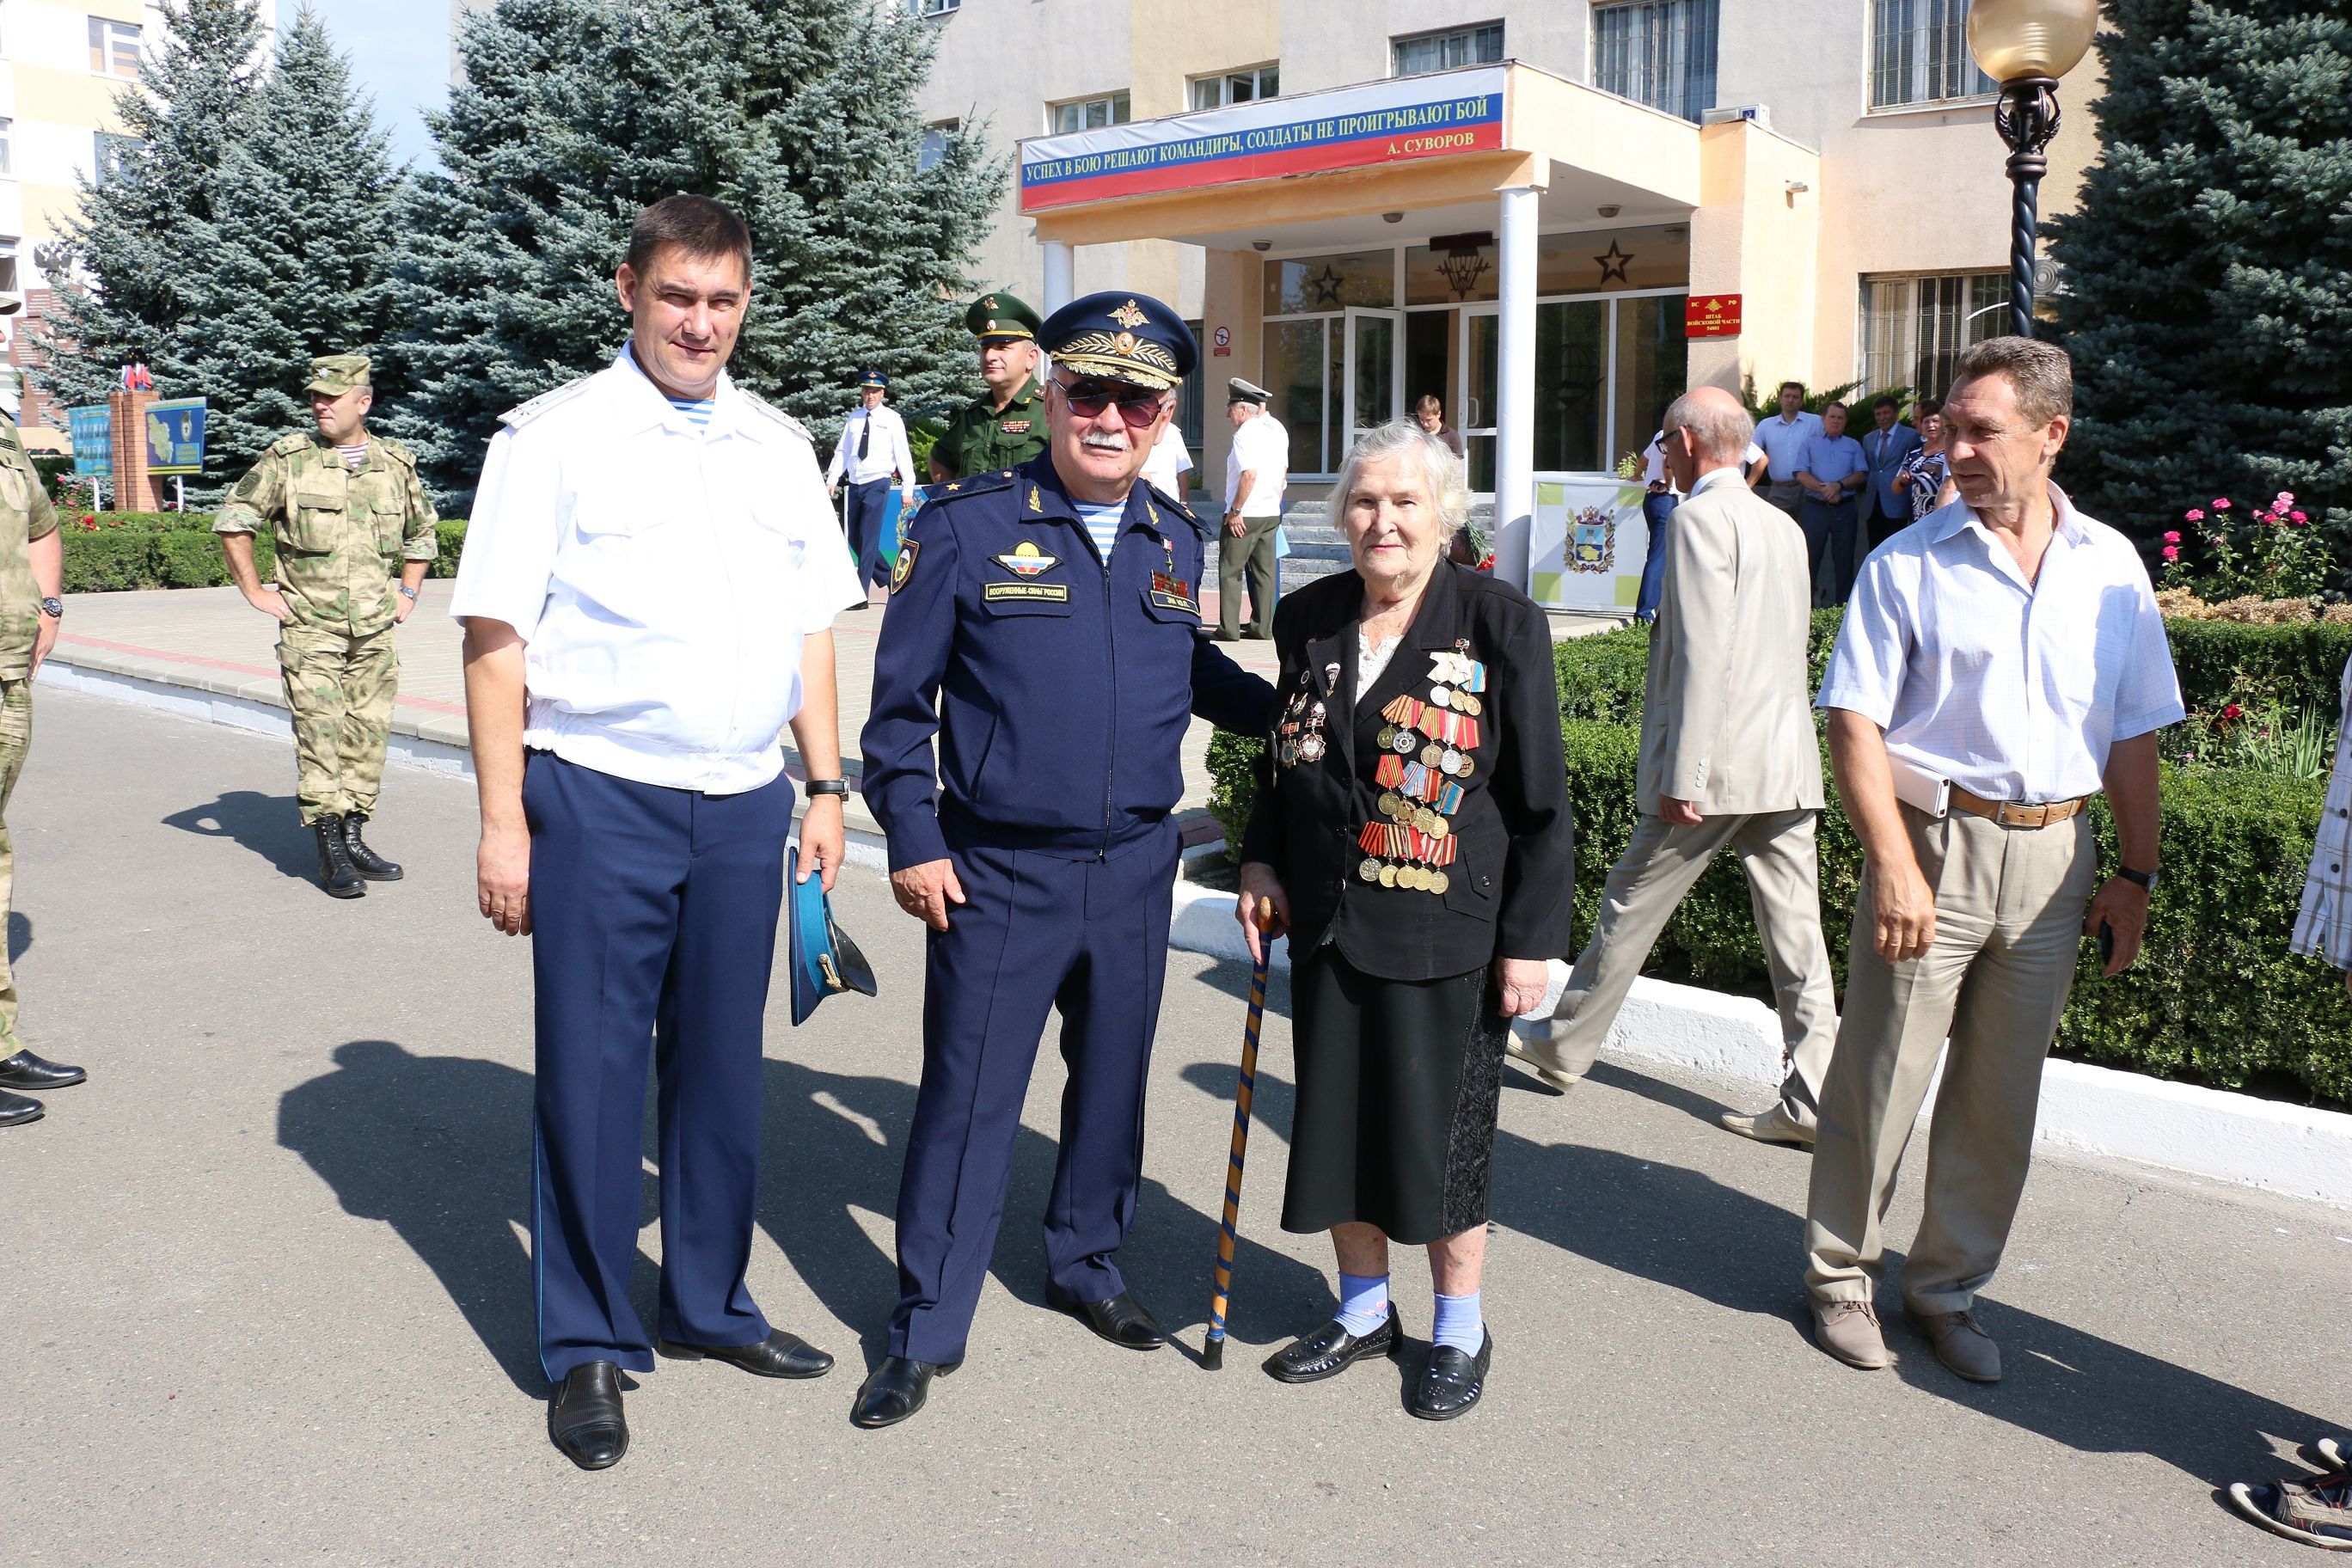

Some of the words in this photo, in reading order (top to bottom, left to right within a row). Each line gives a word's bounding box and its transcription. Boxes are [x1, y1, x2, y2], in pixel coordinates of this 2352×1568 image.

[1026, 161, 1062, 181] УСПЕХ
[1065, 160, 1072, 175] В
[1075, 156, 1101, 175] БОЮ
[1104, 147, 1157, 170] РЕШАЮТ
[1160, 134, 1244, 162] КОМАНДИРЫ,
[1246, 123, 1313, 150] СОЛДАТЫ
[1316, 120, 1335, 139] НЕ
[1338, 103, 1452, 136] ПРОИГРЫВАЮТ
[1455, 95, 1488, 119] БОЙ
[1387, 142, 1400, 155] А.
[1404, 132, 1474, 152] СУВОРОВ
